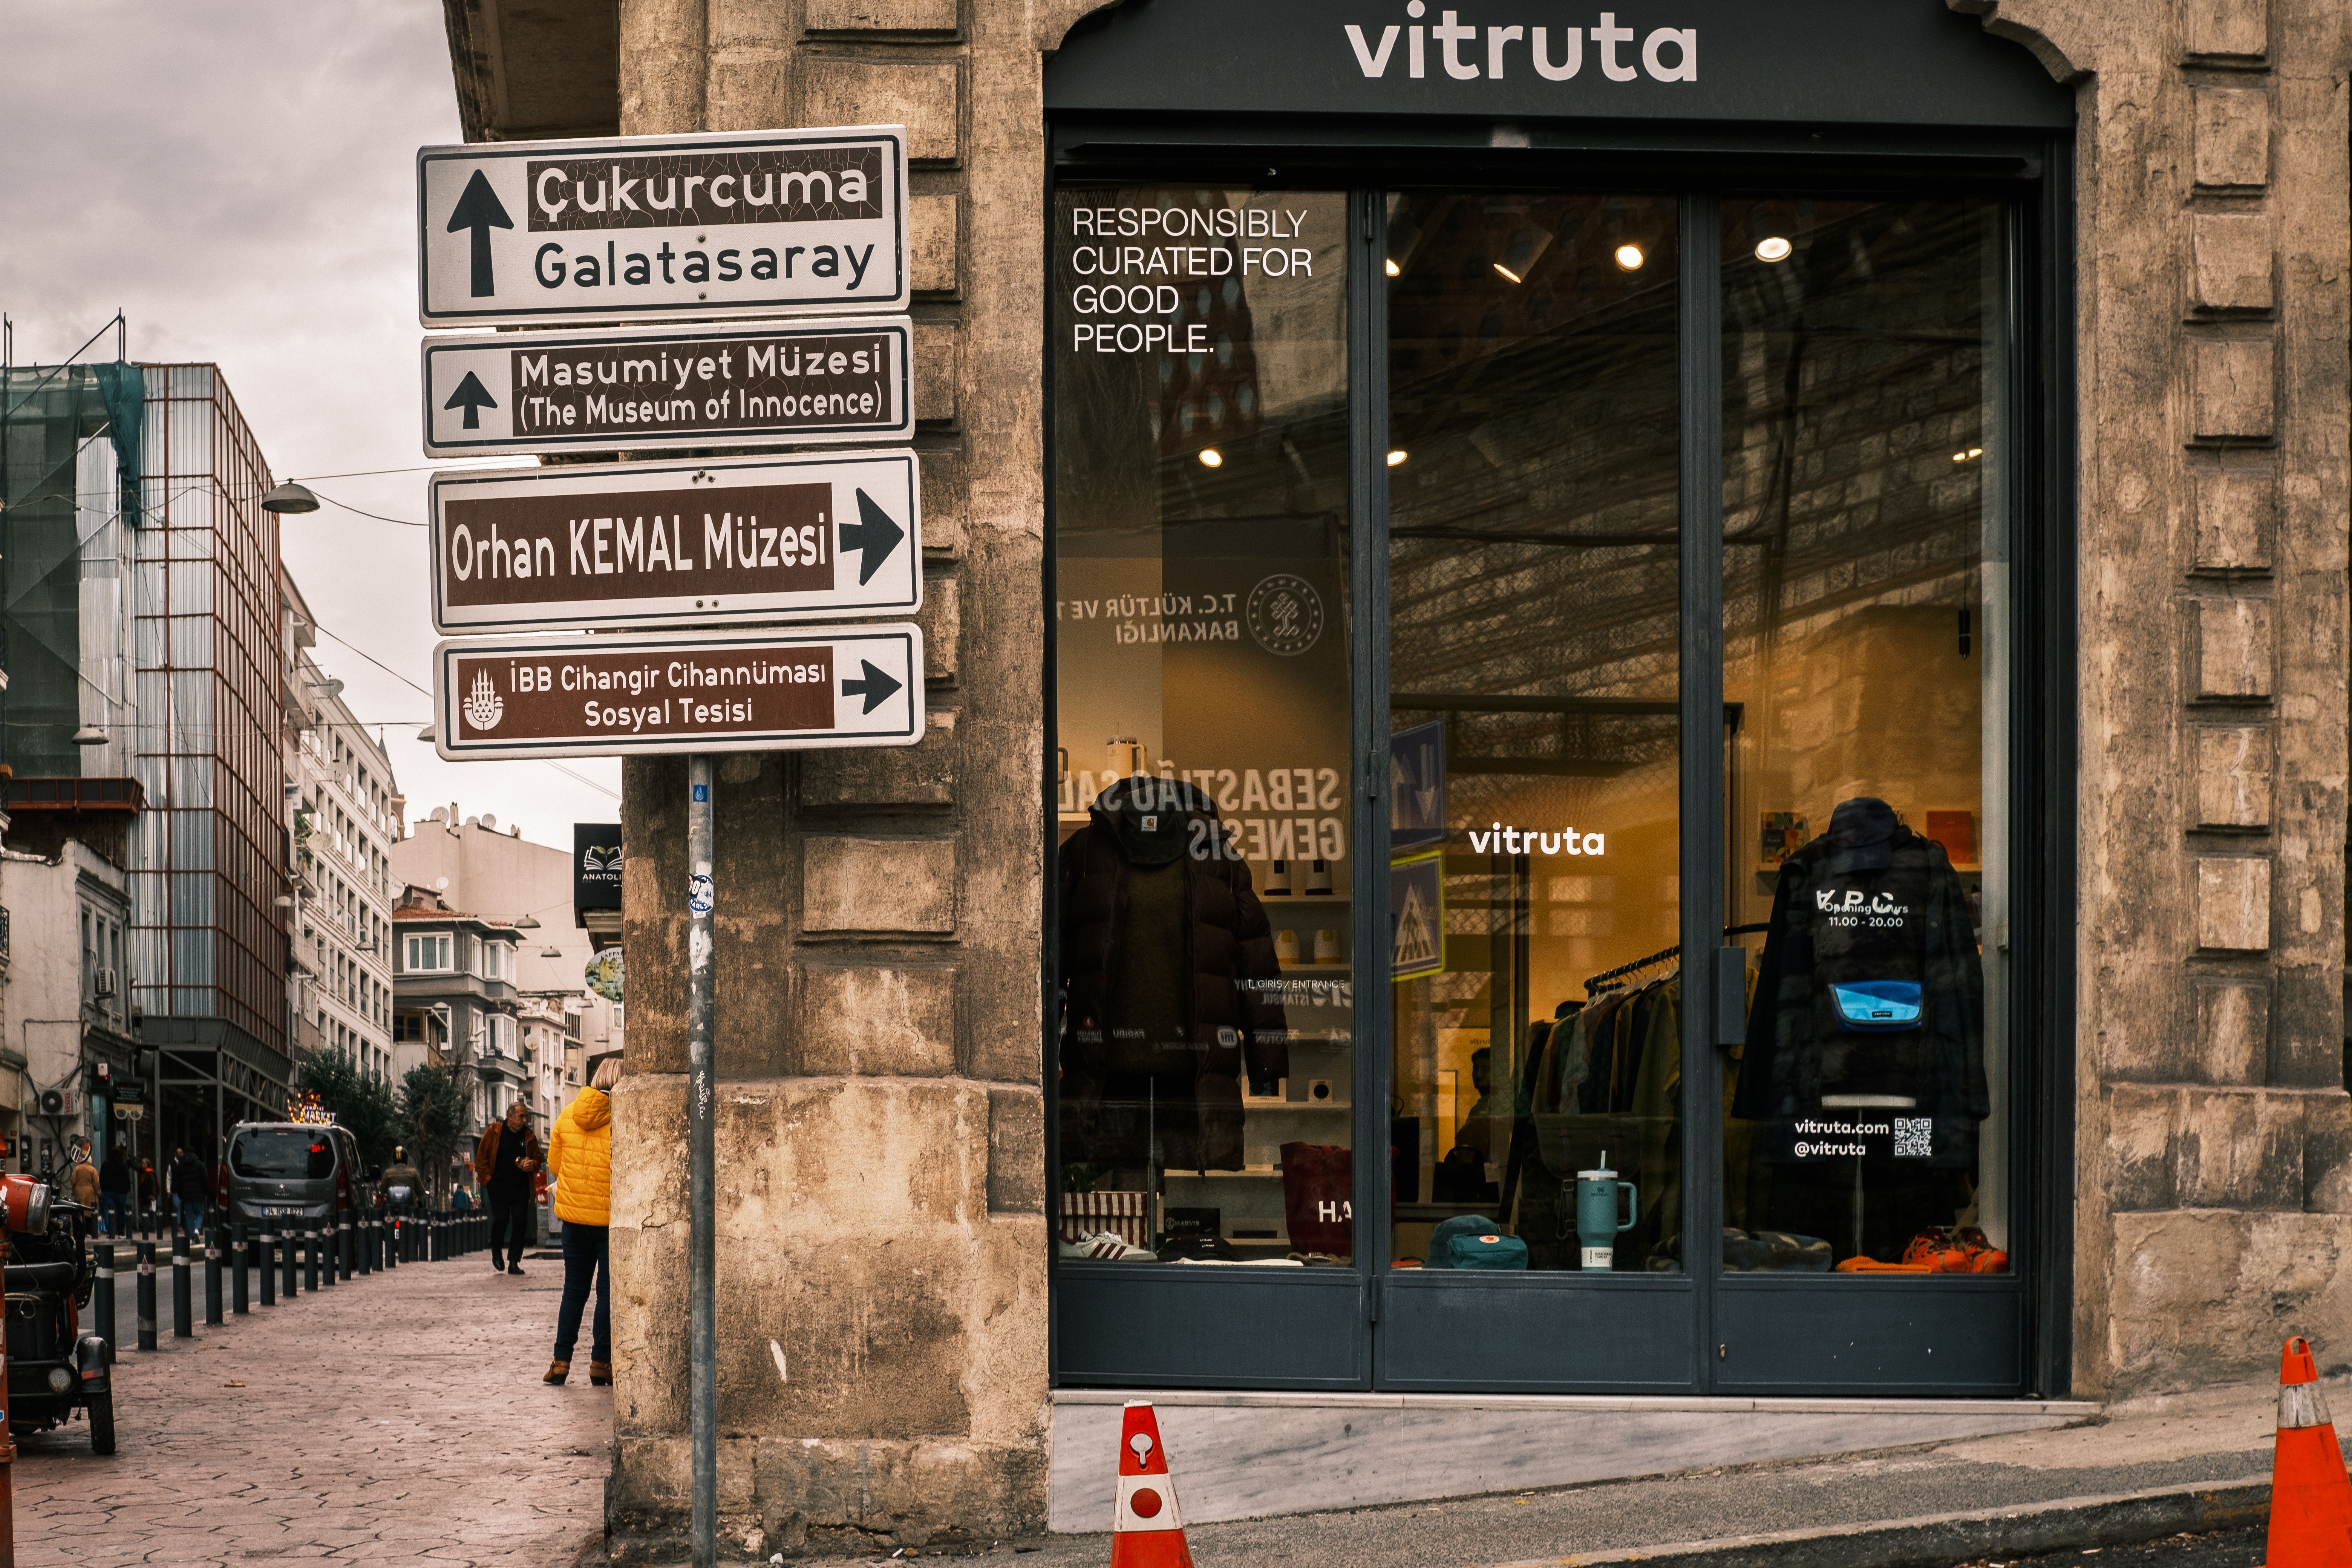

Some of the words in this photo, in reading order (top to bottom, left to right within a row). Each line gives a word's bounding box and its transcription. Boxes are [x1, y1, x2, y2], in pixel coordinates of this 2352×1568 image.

[1344, 0, 1697, 82] vitruta
[536, 166, 867, 223] Çukurcuma
[1074, 208, 1307, 237] RESPONSIBLY
[535, 241, 874, 290] Galatasaray
[1073, 247, 1232, 275] CURATED
[1244, 248, 1312, 276] FOR
[1073, 285, 1178, 313] GOOD
[1075, 324, 1213, 352] PEOPLE.
[521, 350, 732, 390] Masumiyet
[748, 343, 879, 377] Müzesi
[521, 395, 576, 431] (The
[586, 395, 695, 424] Museum
[706, 389, 730, 420] of
[740, 381, 881, 418] Innocence)
[452, 524, 554, 580] Orhan
[570, 515, 692, 575] KEMAL
[704, 513, 825, 569] Müzesi
[511, 661, 551, 692] İBB
[561, 665, 660, 695] Cihangir
[668, 662, 825, 687] Cihannüması
[585, 699, 669, 732] Sosyal
[679, 698, 752, 723] Tesisi
[1469, 822, 1604, 855] vitruta
[1829, 917, 1857, 926] 11.00
[1870, 917, 1903, 926] 20.00
[1292, 980, 1345, 989] ENTRANCE
[1795, 1119, 1888, 1134] vitruta.com
[1795, 1141, 1865, 1157] @vitruta
